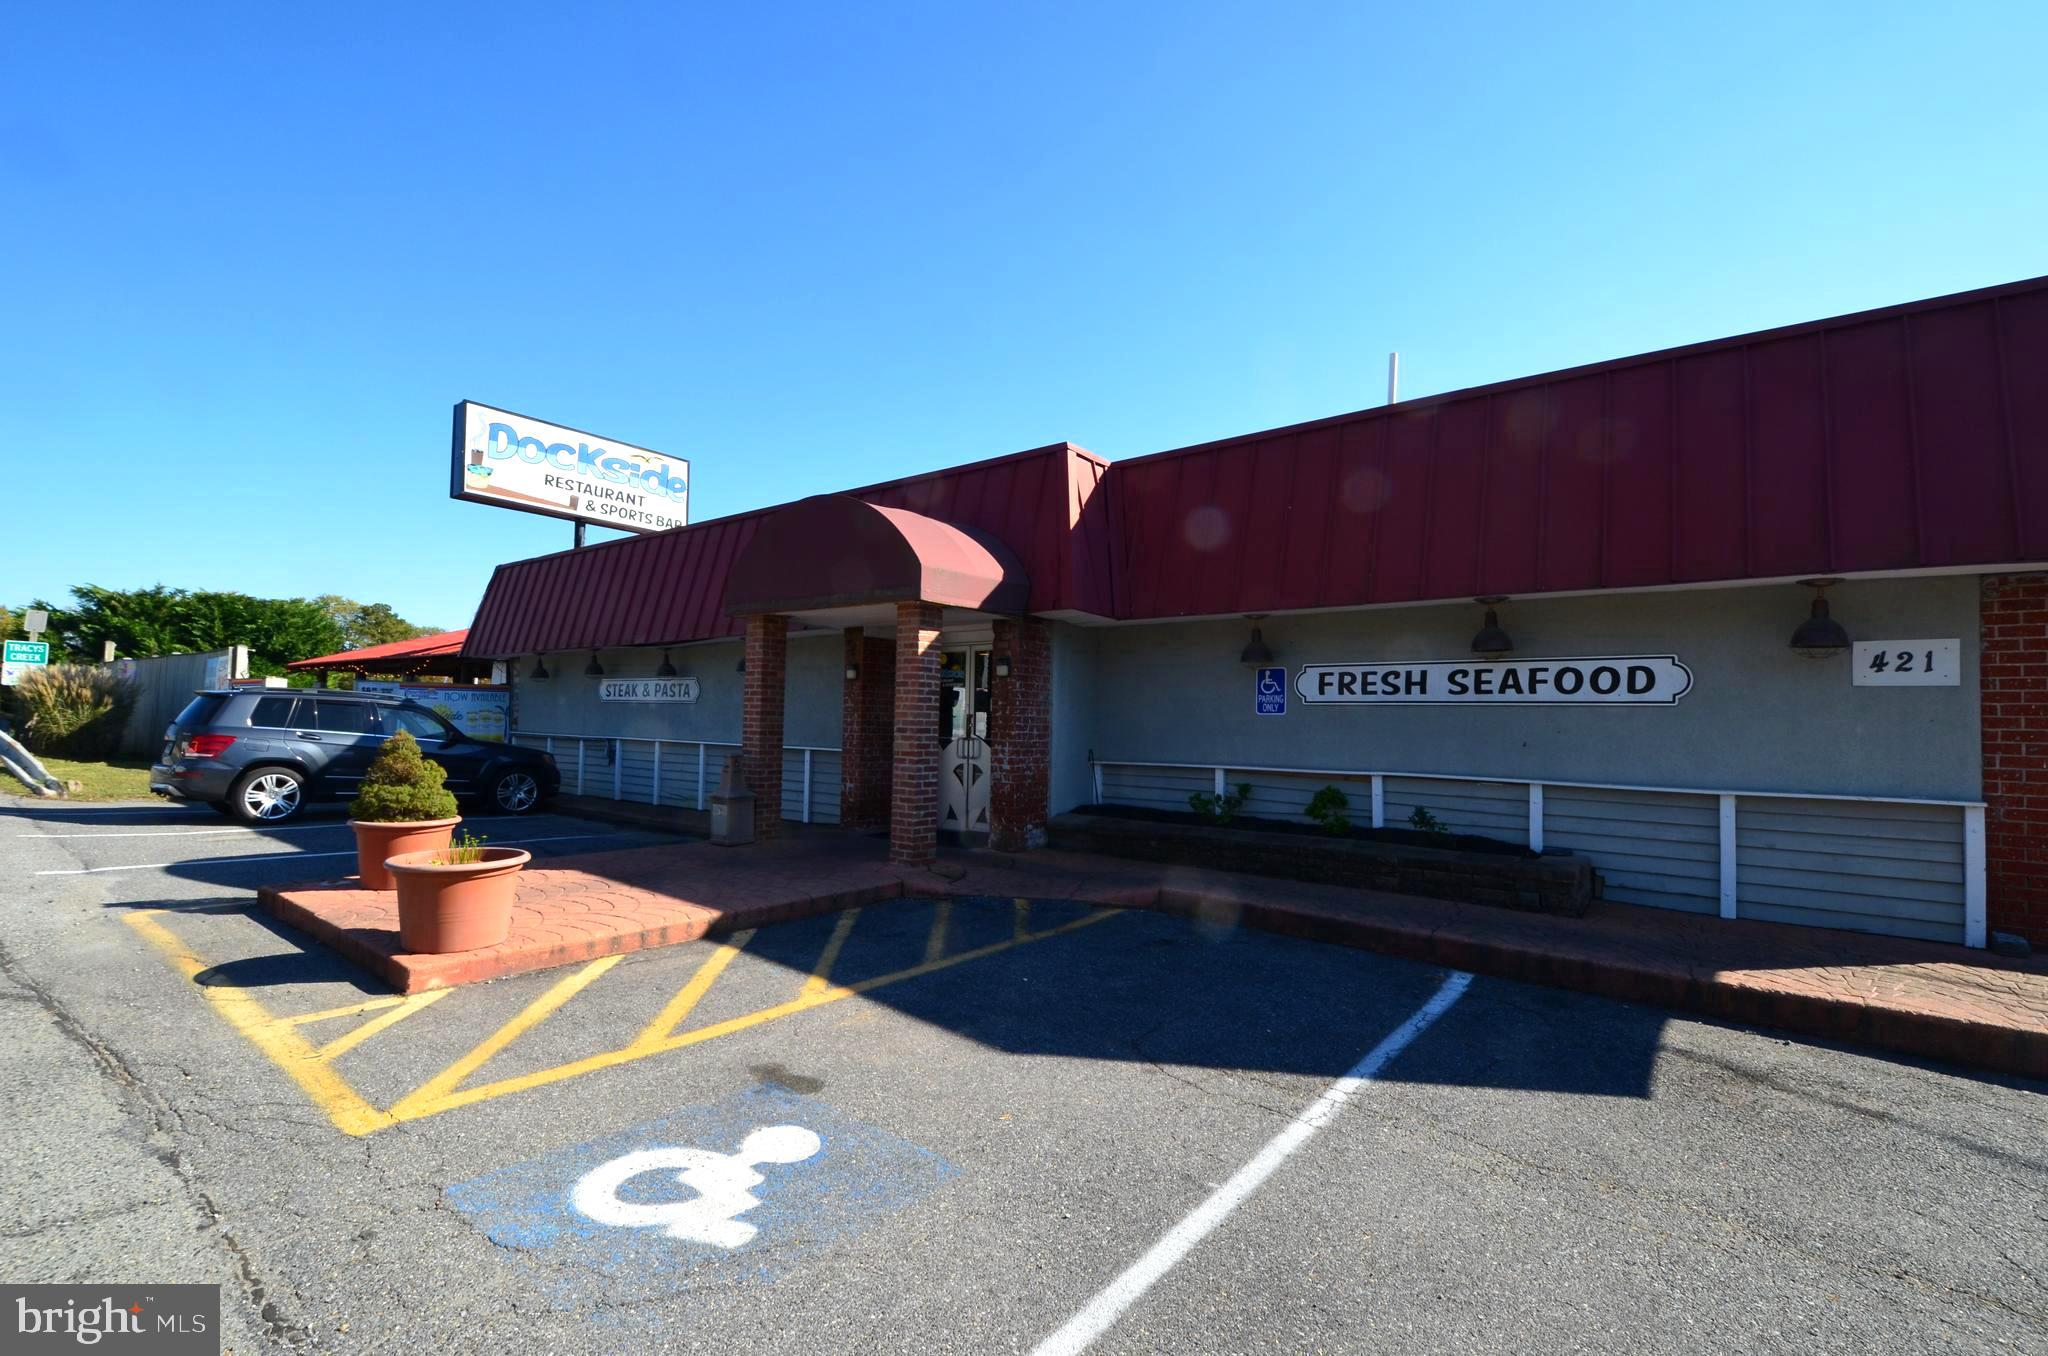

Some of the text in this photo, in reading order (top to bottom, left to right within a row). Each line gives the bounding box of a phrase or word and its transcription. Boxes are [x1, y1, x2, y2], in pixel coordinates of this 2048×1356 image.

[544, 474, 647, 507] RESTAURANT
[585, 500, 596, 512] &
[600, 503, 654, 524] SPORTS
[8, 643, 44, 653] TRACYS
[10, 653, 41, 662] CREEK
[1869, 650, 1934, 673] 421
[1318, 665, 1656, 695] FRESH SEAFOOD
[606, 682, 690, 698] STEAK & PASTA
[1258, 694, 1284, 704] PARKING
[1262, 703, 1279, 712] ONLY
